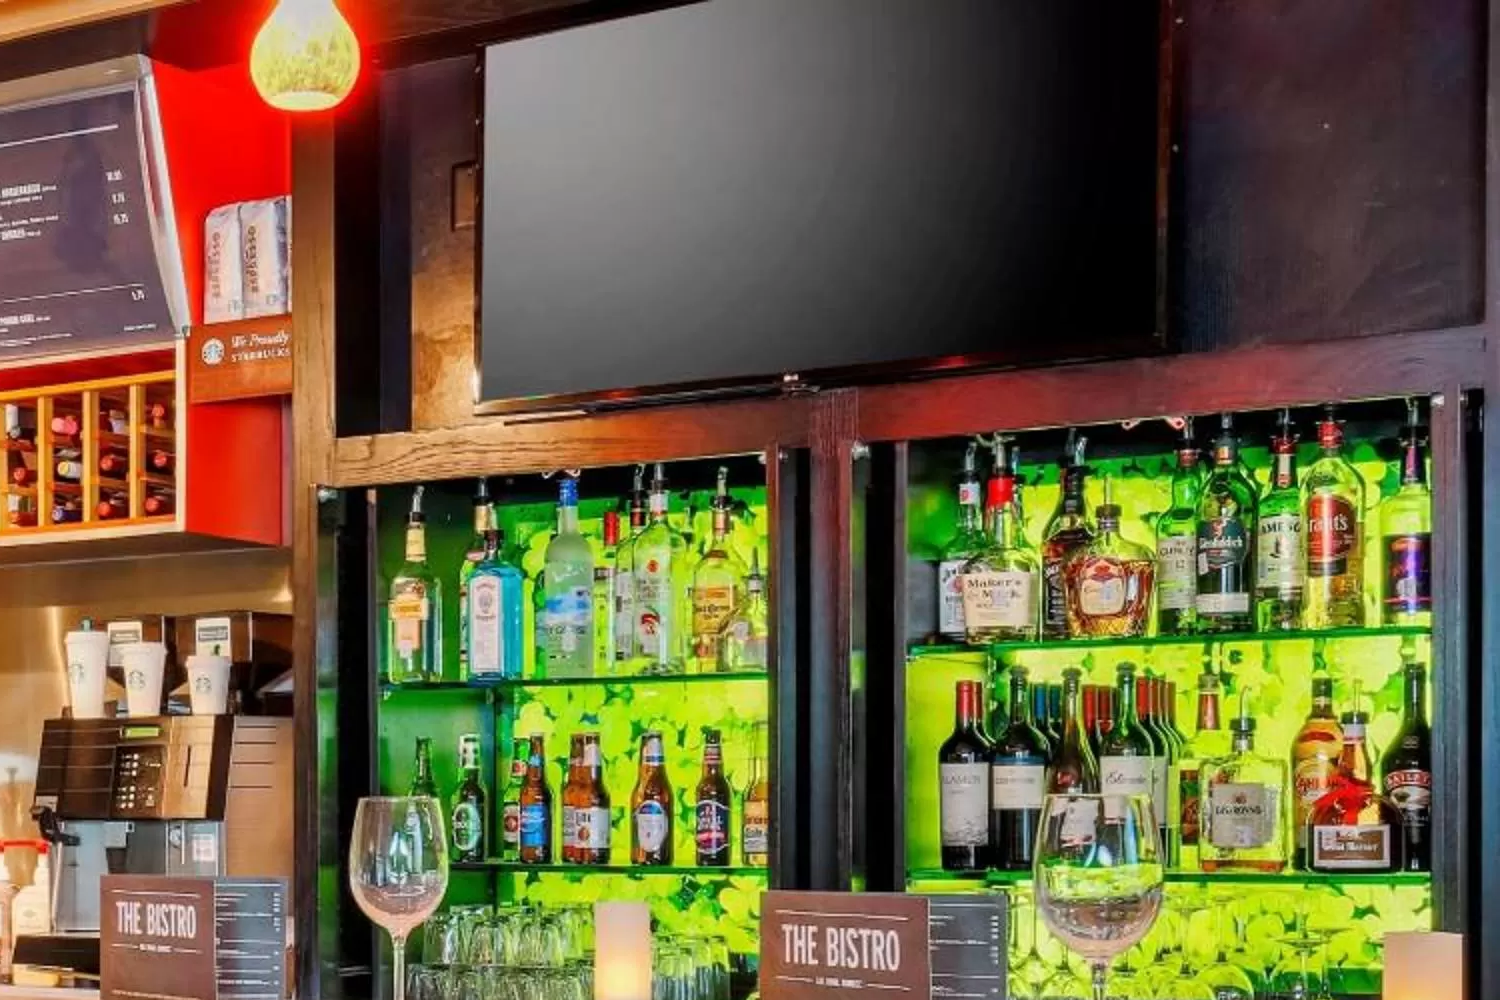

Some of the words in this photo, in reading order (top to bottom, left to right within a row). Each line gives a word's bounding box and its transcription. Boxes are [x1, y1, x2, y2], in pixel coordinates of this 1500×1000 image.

[116, 901, 143, 935] THE
[146, 903, 197, 939] BISTRO
[781, 924, 819, 966] THE
[826, 927, 901, 972] BISTRO
